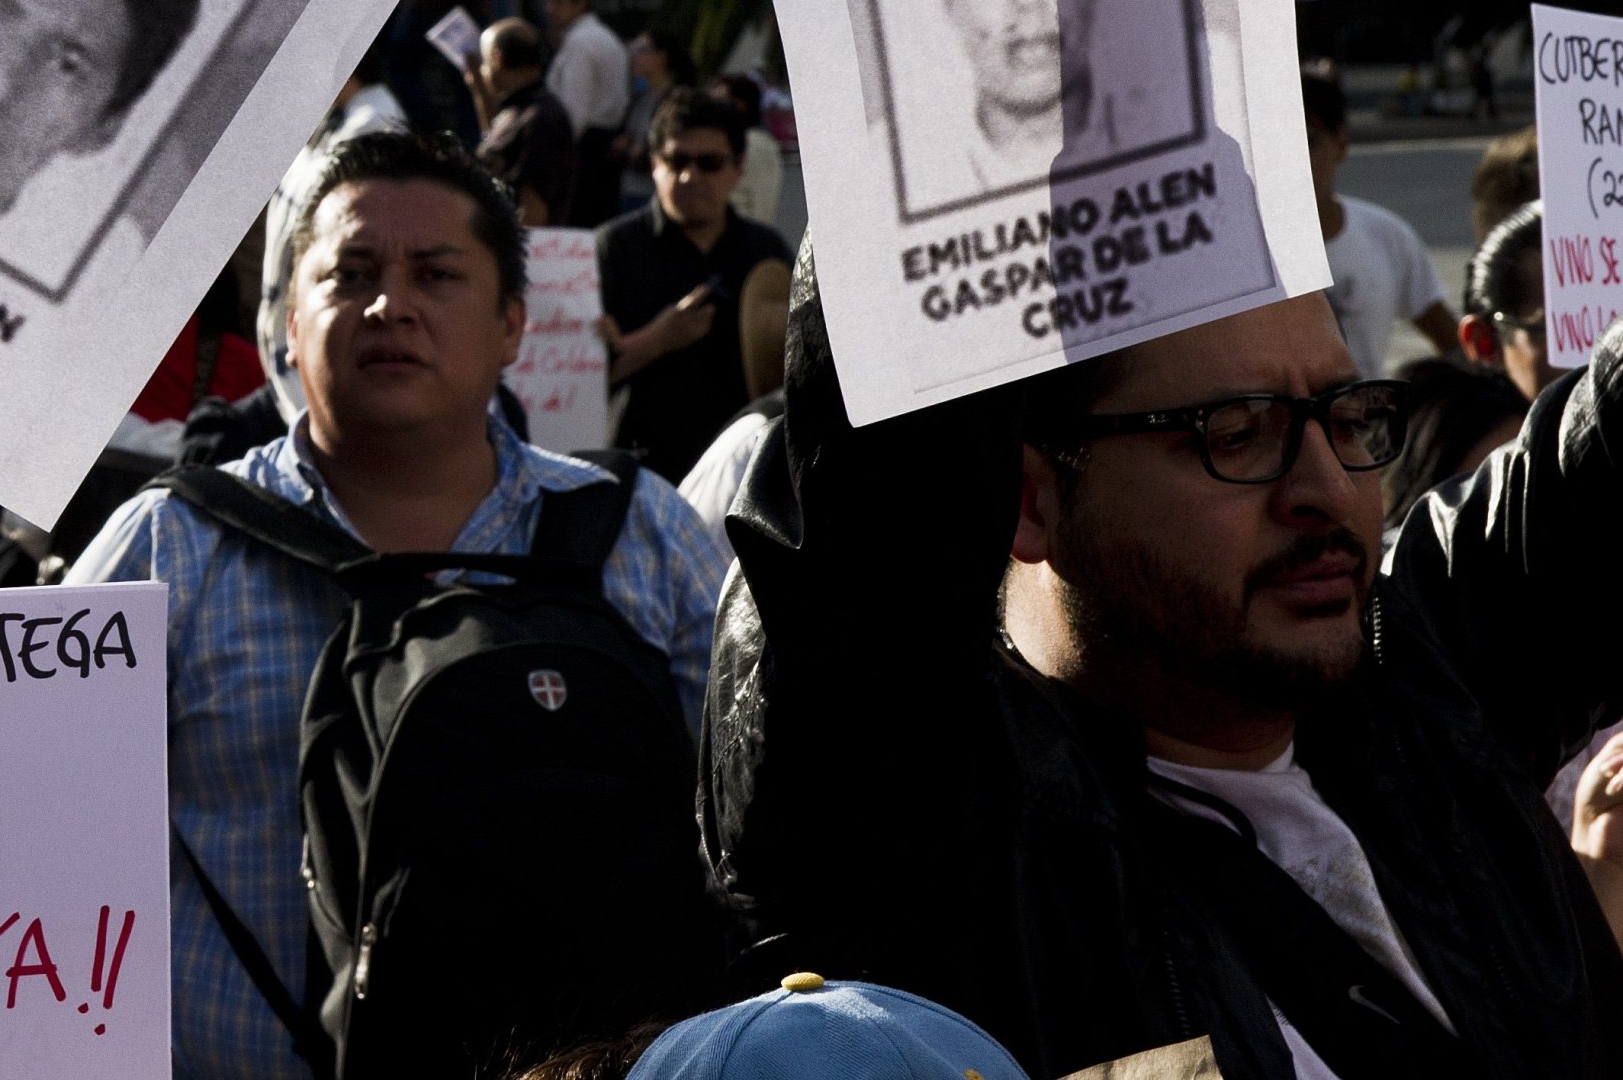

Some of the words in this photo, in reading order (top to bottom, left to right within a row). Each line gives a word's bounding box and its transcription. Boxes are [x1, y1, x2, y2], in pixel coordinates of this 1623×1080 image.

[901, 198, 1101, 283] EMILIANO
[1109, 161, 1217, 226] ALEN
[920, 246, 1086, 322] GASPAR
[1091, 225, 1151, 275] DE
[1156, 211, 1214, 257] LA
[1021, 277, 1136, 340] CRUZ
